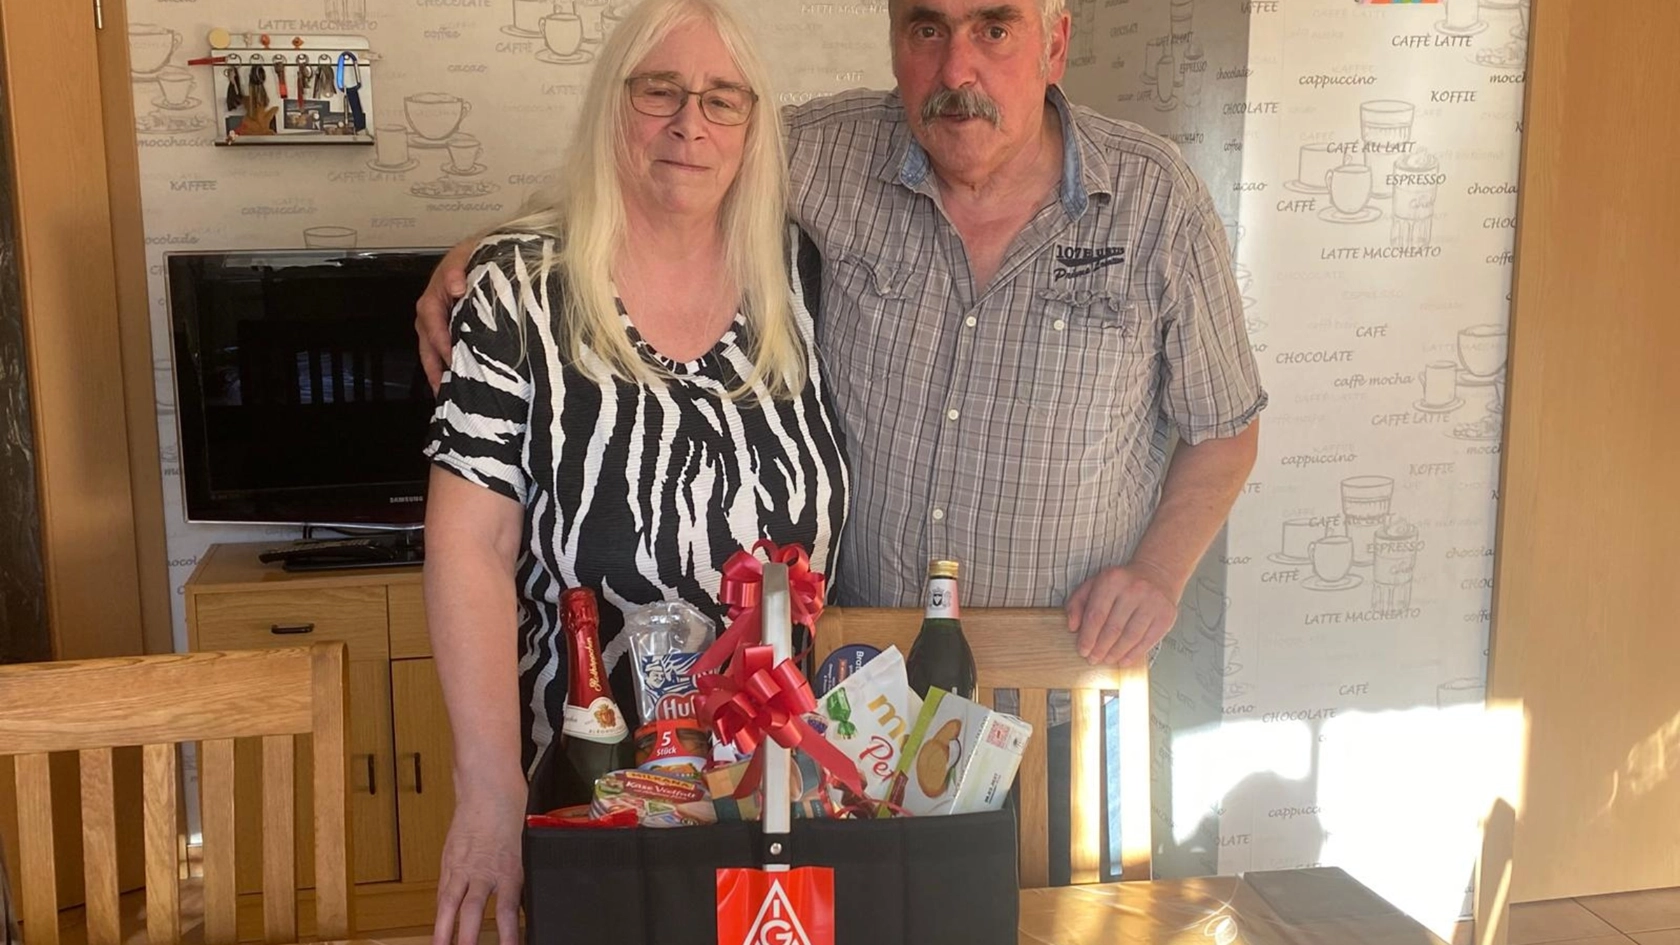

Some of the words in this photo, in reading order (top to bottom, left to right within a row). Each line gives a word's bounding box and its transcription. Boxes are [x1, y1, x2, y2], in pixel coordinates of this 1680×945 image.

[257, 19, 297, 31] LATTE
[1391, 32, 1431, 49] CAFFÈ
[1434, 34, 1474, 48] LATTE
[447, 63, 488, 74] cacao
[1298, 73, 1378, 89] cappuccino
[1430, 90, 1477, 104] KOFFIE
[1222, 101, 1280, 116] CHOCOLATE
[1326, 140, 1360, 155] CAFÉ
[169, 179, 218, 192] KAFFEE
[1385, 173, 1447, 187] ESPRESSO
[240, 205, 318, 219] cappuccino
[426, 201, 504, 213] mocchacino
[1275, 197, 1317, 214] CAFFÈ
[1320, 246, 1361, 261] LATTE
[1362, 245, 1443, 260] MACCHIATO
[1355, 322, 1389, 339] CAFÉ
[1275, 350, 1356, 365] CHOCOLATE
[1368, 372, 1415, 386] mocha
[1371, 410, 1410, 427] CAFFÈ
[1412, 412, 1451, 424] LATTE
[1280, 452, 1358, 469] cappuccino
[1409, 462, 1456, 476] KOFFIE
[1308, 512, 1341, 528] CAFÉ
[1366, 540, 1427, 555] ESPRESSO
[1260, 567, 1300, 584] CAFFÈ
[1304, 612, 1342, 626] LATTE
[1345, 608, 1422, 623] MACCHIATO
[1338, 682, 1370, 697] CAFÉ
[1262, 707, 1338, 723] CHOCOLATE
[660, 731, 672, 747] 5
[656, 745, 677, 757] Stück
